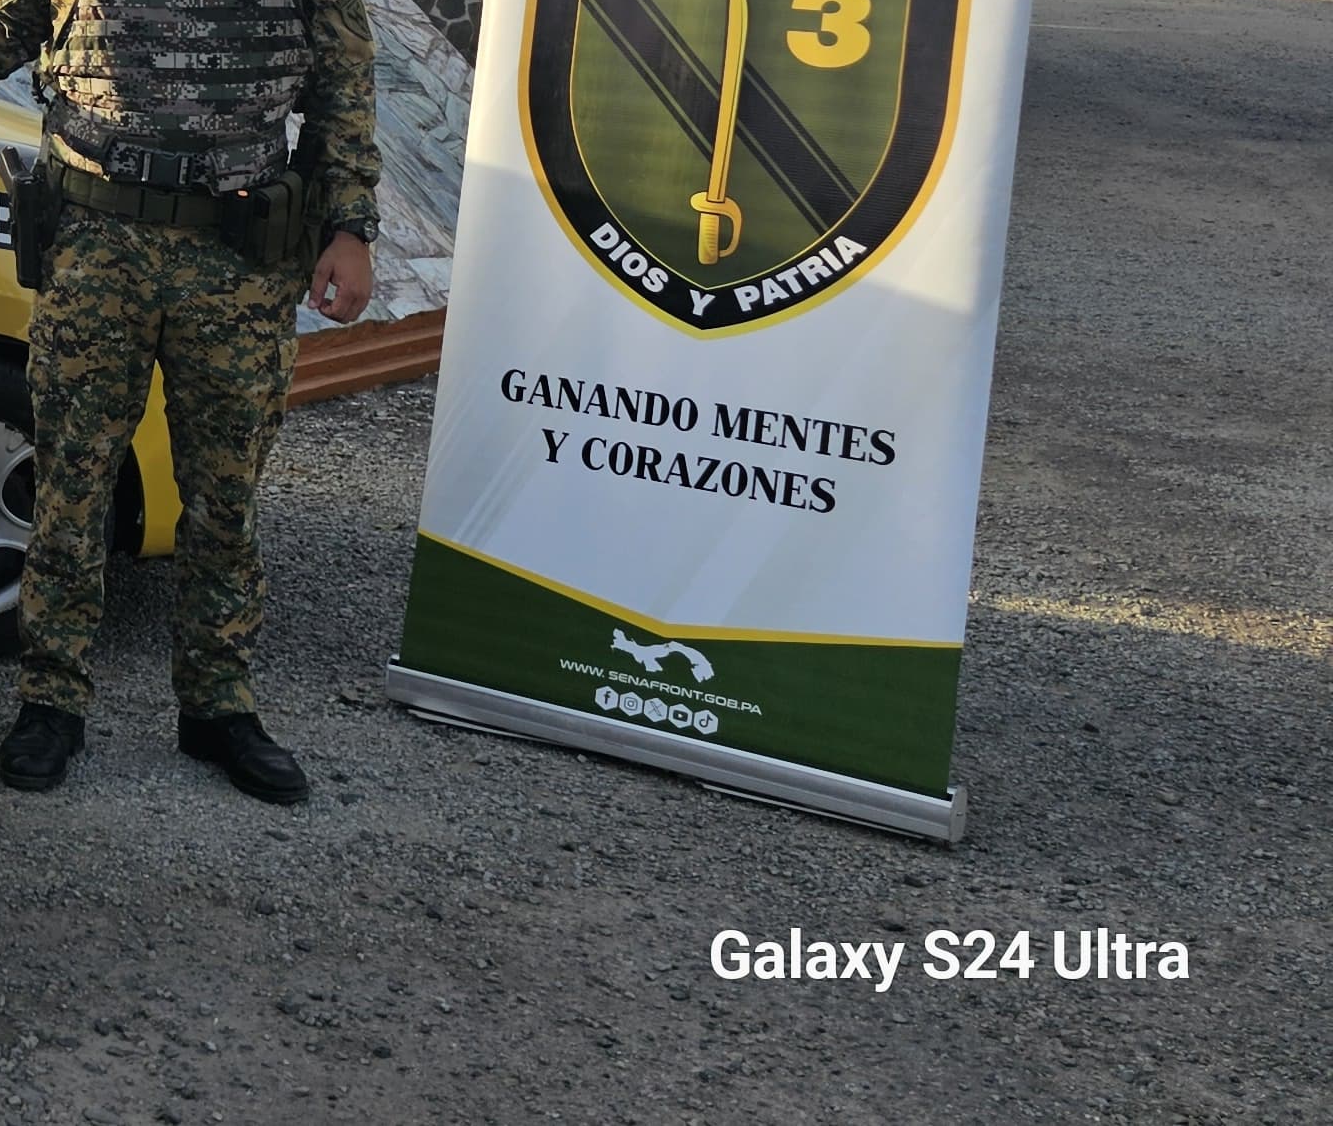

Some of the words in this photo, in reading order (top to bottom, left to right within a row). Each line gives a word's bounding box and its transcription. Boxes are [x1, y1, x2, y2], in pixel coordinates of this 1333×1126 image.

[589, 222, 669, 294] DIOS
[689, 288, 715, 317] Y
[733, 235, 867, 312] PATRIA
[501, 368, 698, 432] GANANDO
[712, 402, 896, 466] MENTES
[540, 428, 569, 464] Y
[581, 436, 836, 513] CORAZONES
